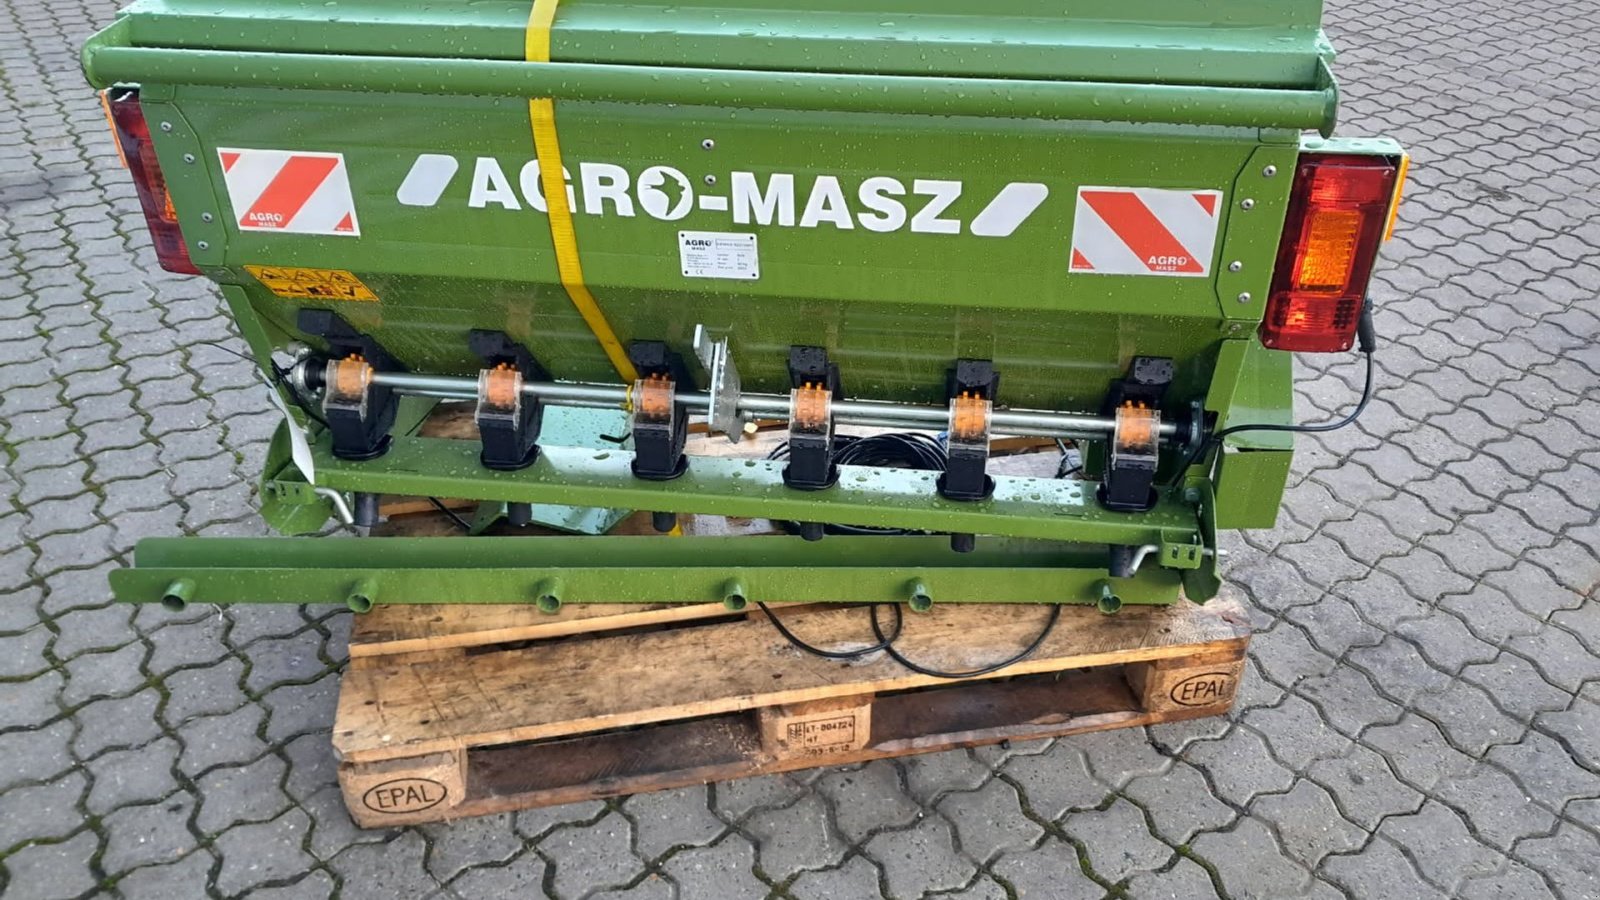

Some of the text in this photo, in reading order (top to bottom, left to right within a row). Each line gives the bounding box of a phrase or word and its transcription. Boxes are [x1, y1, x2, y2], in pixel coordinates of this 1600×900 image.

[468, 155, 963, 235] AGRO-MASZ
[249, 212, 283, 223] AGRO
[685, 239, 712, 247] AGRO
[1148, 255, 1187, 266] AGRO
[1180, 679, 1225, 701] EPAL
[375, 784, 436, 809] EPAL
